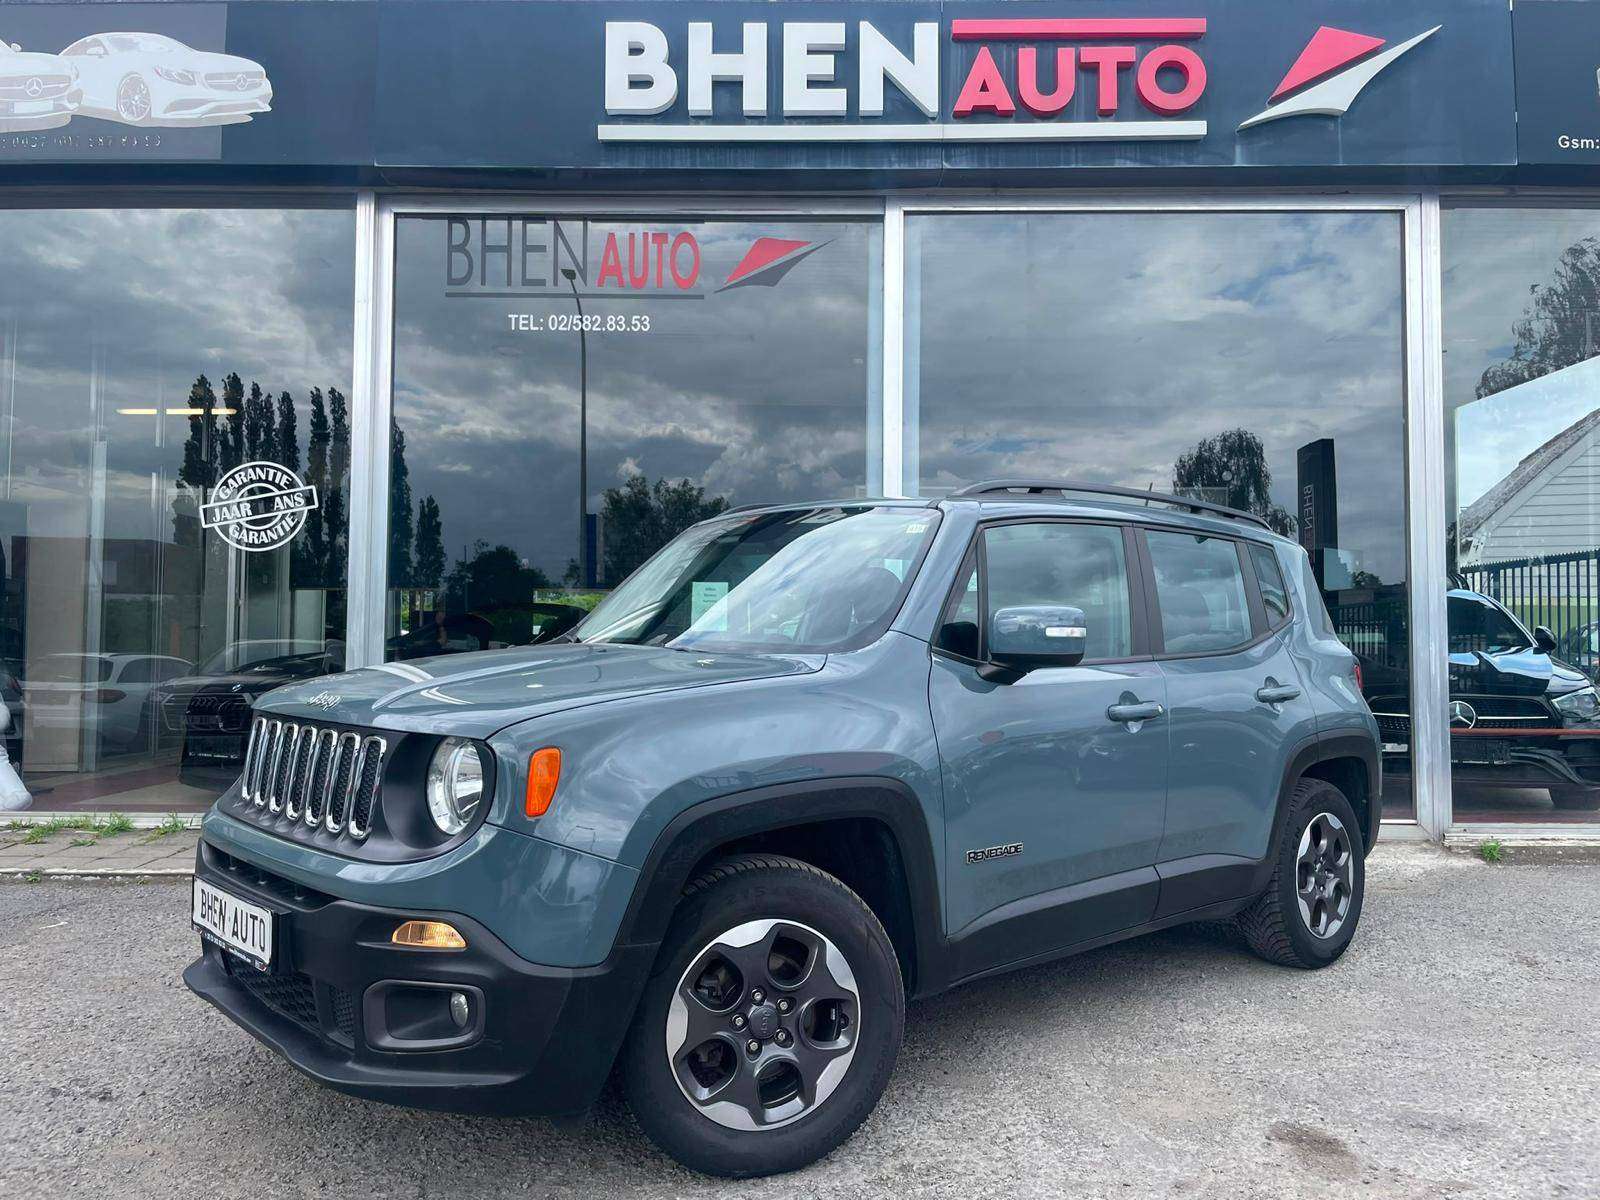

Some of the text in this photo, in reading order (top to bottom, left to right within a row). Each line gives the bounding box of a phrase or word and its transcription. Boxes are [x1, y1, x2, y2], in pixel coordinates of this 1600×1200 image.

[605, 21, 1208, 118] BHEN AUTO
[1557, 135, 1600, 149] Gsm:
[446, 217, 701, 289] BHEN AUTO
[508, 314, 651, 332] TEL: 02/582.83.53
[218, 467, 292, 500] GARANTIE
[212, 492, 305, 523] JAAR ANS
[229, 511, 298, 545] GARANTIE
[966, 842, 1024, 864] RENEGADE
[200, 888, 266, 952] BHEN AUTO
